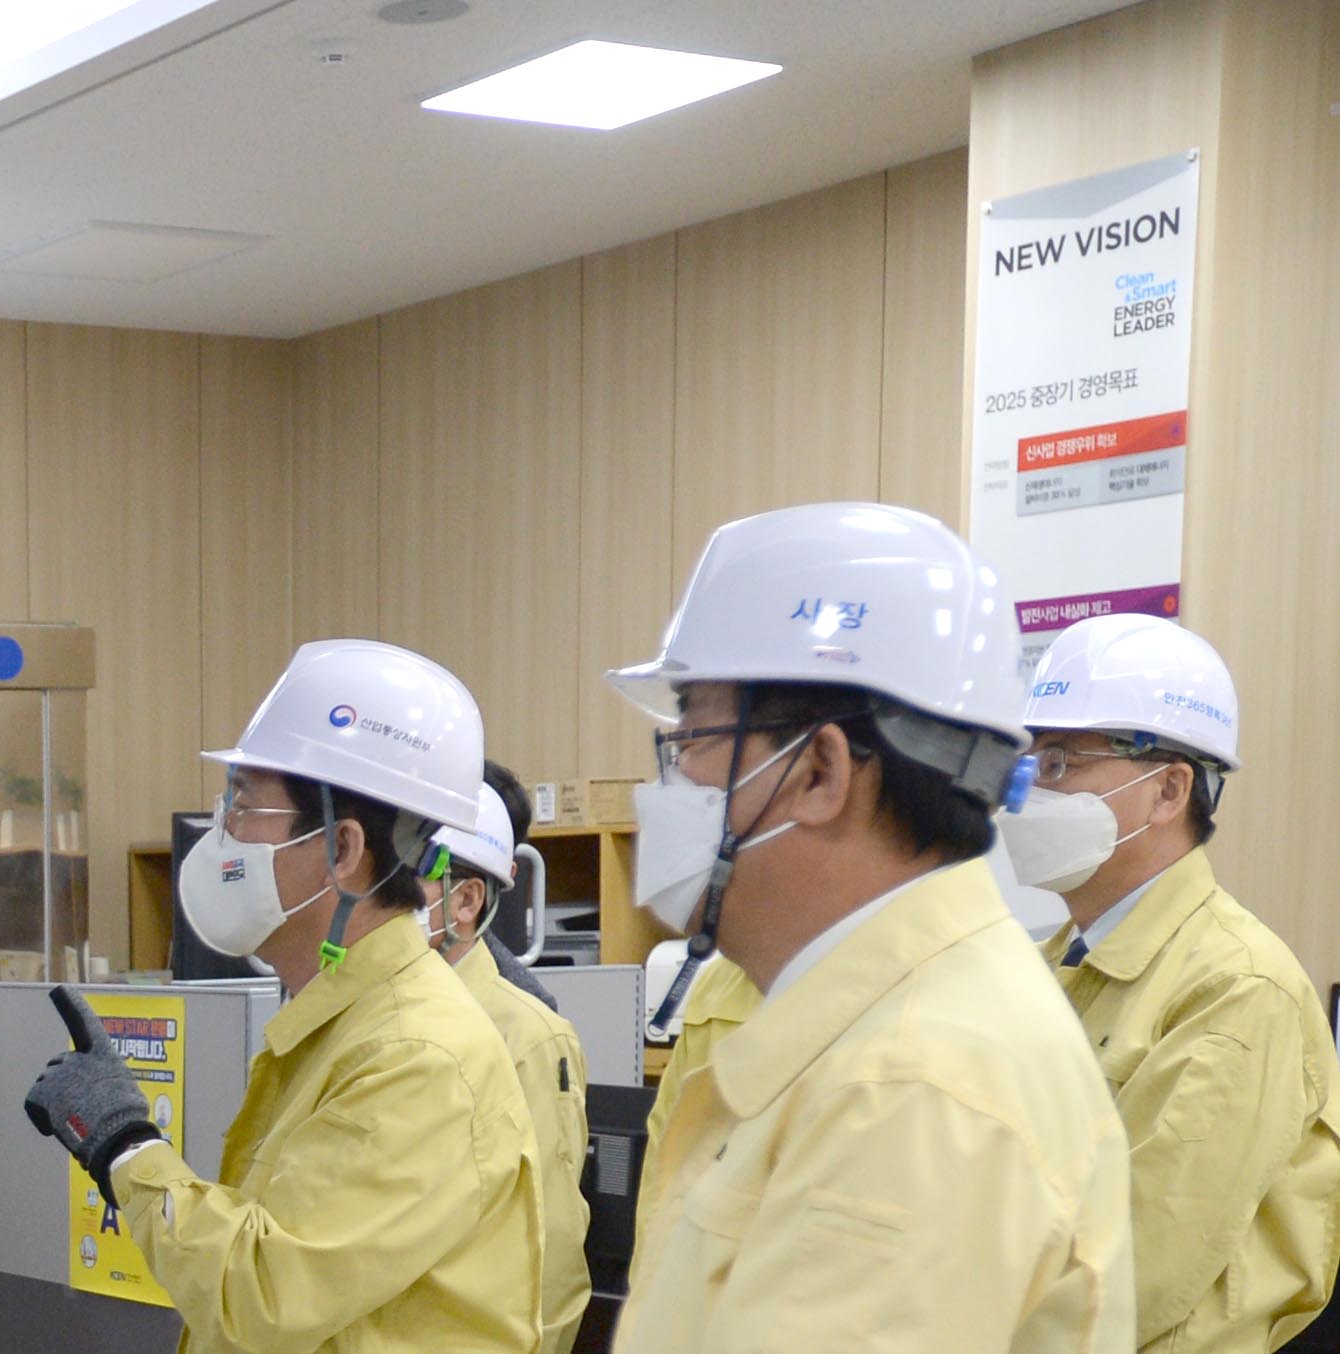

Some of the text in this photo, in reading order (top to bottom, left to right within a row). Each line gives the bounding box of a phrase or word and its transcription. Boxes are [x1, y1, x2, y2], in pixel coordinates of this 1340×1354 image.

[993, 207, 1181, 276] NEW VISION
[1114, 271, 1155, 290] Clean
[1113, 296, 1176, 322] ENERGY
[1113, 312, 1176, 338] LEADER
[984, 389, 1028, 414] 2025
[1078, 368, 1139, 399] 경영목표
